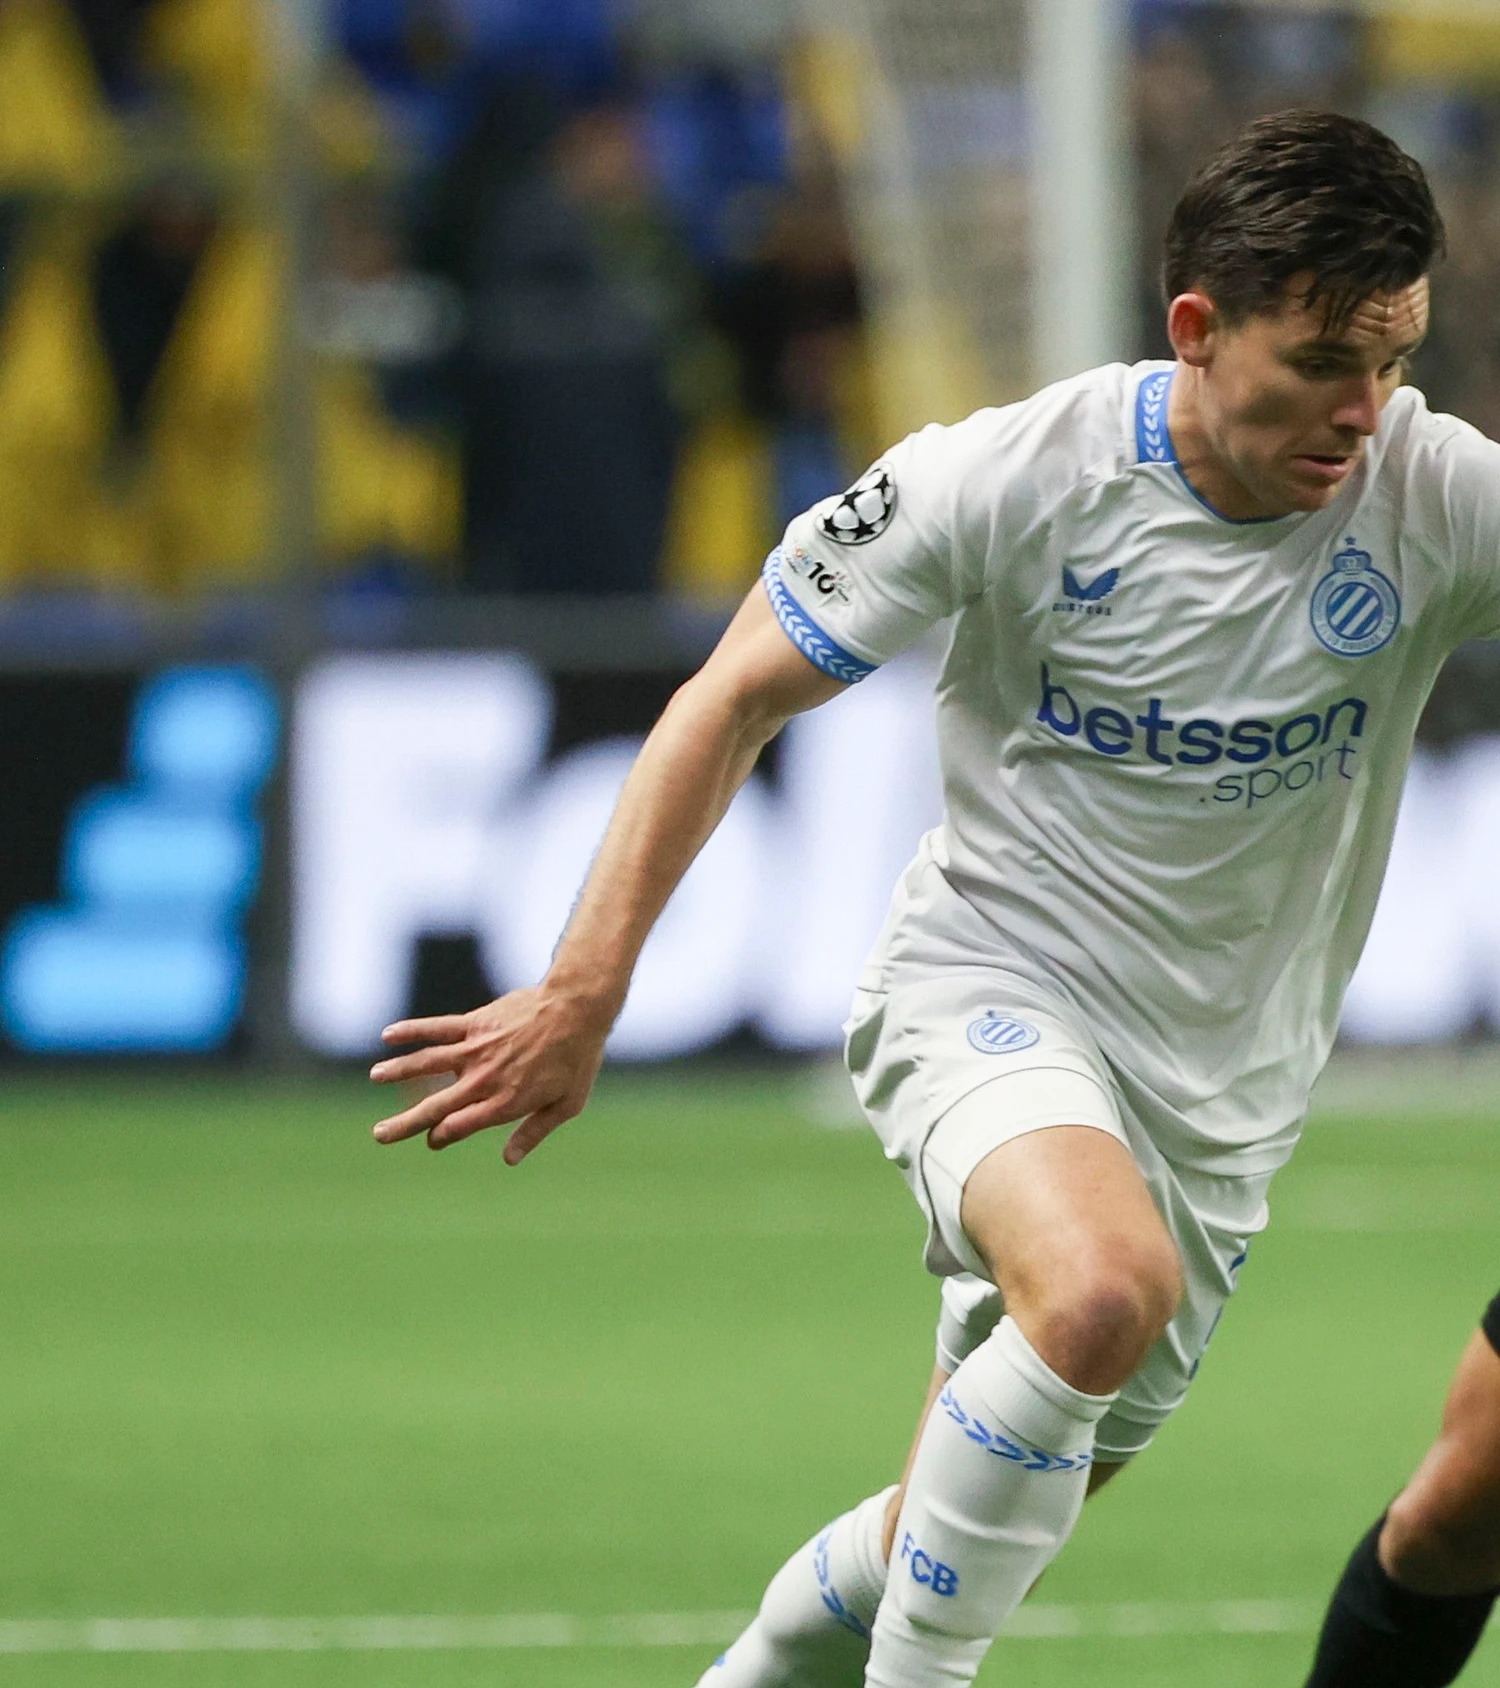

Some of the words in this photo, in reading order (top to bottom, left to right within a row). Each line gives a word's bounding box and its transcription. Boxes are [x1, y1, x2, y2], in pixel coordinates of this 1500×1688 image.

[1037, 659, 1368, 766] betsson
[1199, 739, 1357, 809] .sport
[901, 1531, 959, 1597] FCB
